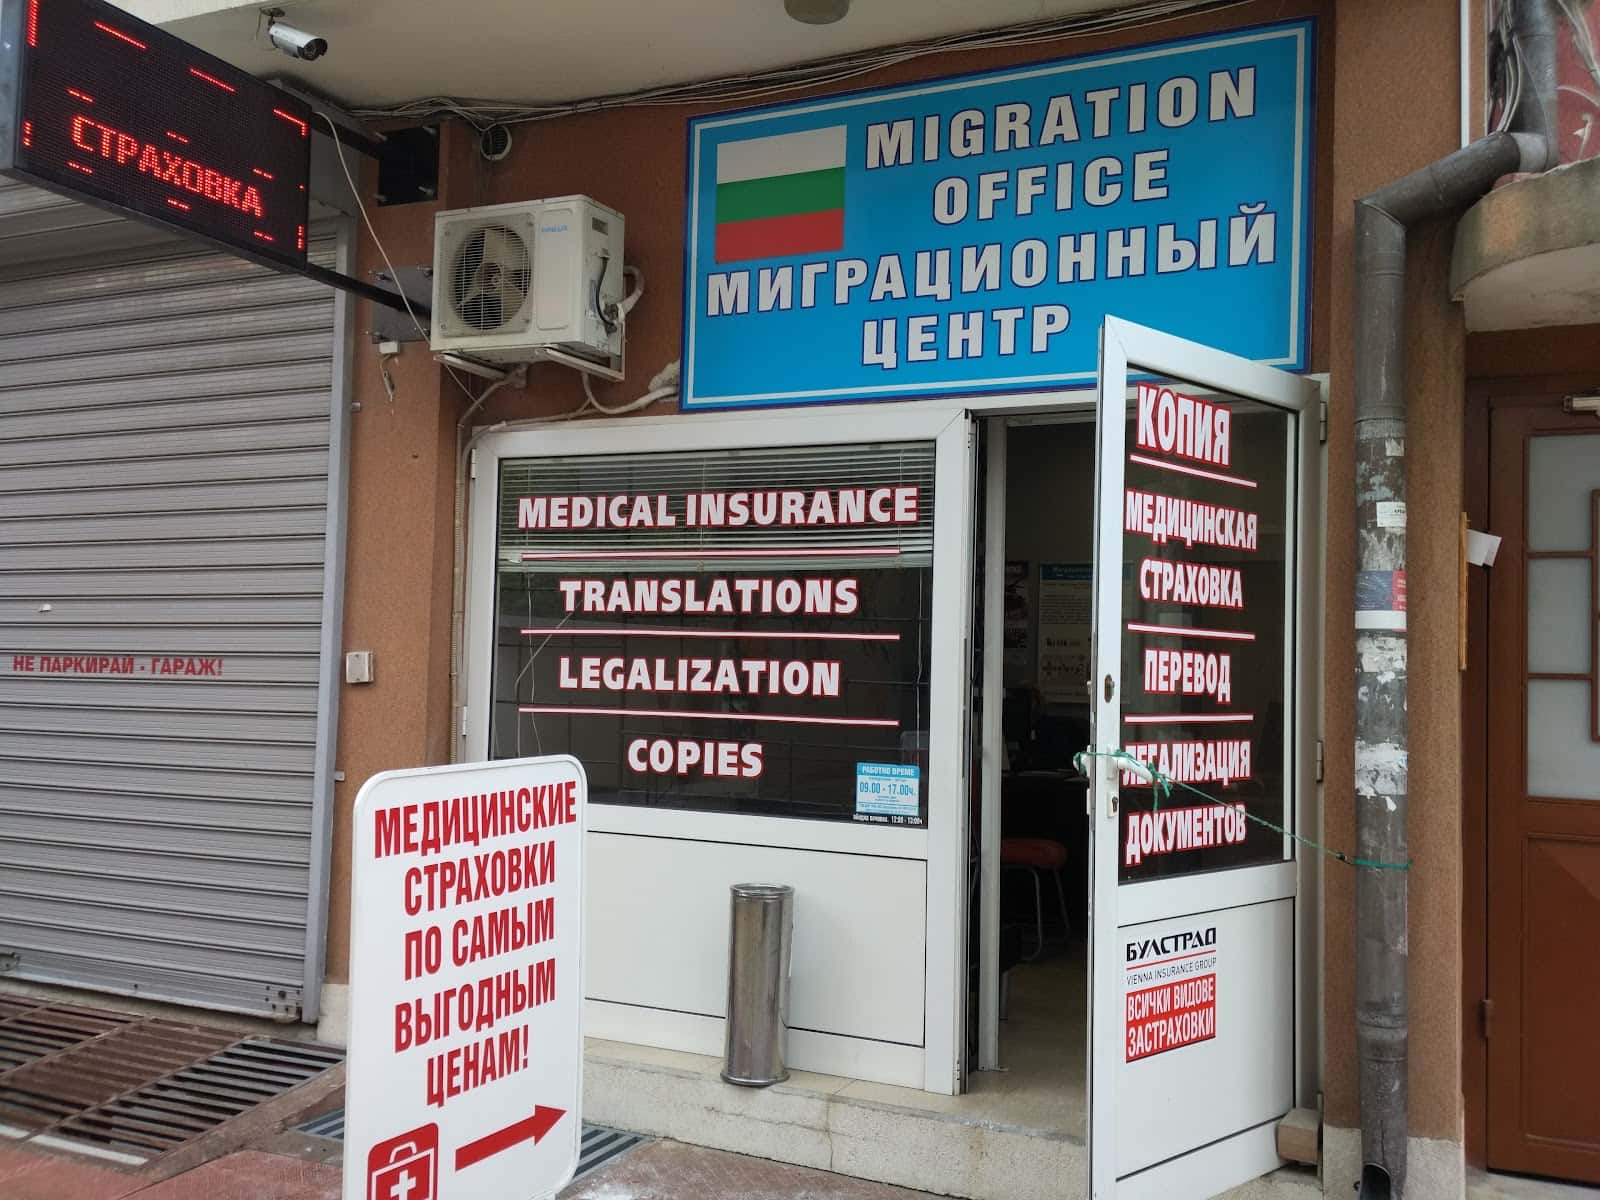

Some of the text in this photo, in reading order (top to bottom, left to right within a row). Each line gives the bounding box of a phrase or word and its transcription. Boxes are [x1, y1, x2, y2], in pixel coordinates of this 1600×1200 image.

[866, 65, 1257, 169] MIGRATION
[72, 116, 264, 216] СТРАХОВКА
[933, 149, 1170, 225] OFFICE
[707, 202, 1277, 317] МИГРАЦИОННЫЙ
[862, 304, 1071, 369] ЦЕНТР
[1137, 383, 1232, 466] КОПИЯ
[517, 487, 920, 529] MEDICAL INSURANCE
[1125, 489, 1257, 550] МЕДИЦИНСКАЯ
[559, 579, 858, 614] TRANSLATIONS
[1140, 558, 1243, 608] СТРАХОВКА
[13, 655, 34, 672] НЕ
[39, 655, 134, 673] ПАРКИРАЙ
[151, 657, 224, 676] ГАРАЖ!
[559, 657, 840, 697] LEGALIZATION
[1144, 649, 1231, 702] ПЕРЕВОД
[627, 739, 764, 778] COPIES
[860, 782, 880, 794] 09.00
[374, 781, 576, 858] МЕДИЦИНСКИЕ
[1125, 804, 1246, 866] ДОКУМЕНТОВ
[404, 840, 555, 916] СТРАХОВКИ
[405, 897, 555, 982] ПО САМЫМ
[1126, 927, 1216, 962] БУЛСТРАД
[1127, 957, 1216, 985] VIENNA INSURANCE GROUP
[1128, 977, 1214, 1021] ВСИЧКИ ВИДОВЕ
[395, 958, 555, 1053] ВЫГОДНЫМ
[1127, 1007, 1214, 1057] ЗАСТРАХОВКИ
[426, 1024, 529, 1108] ЦЕНАМ!
